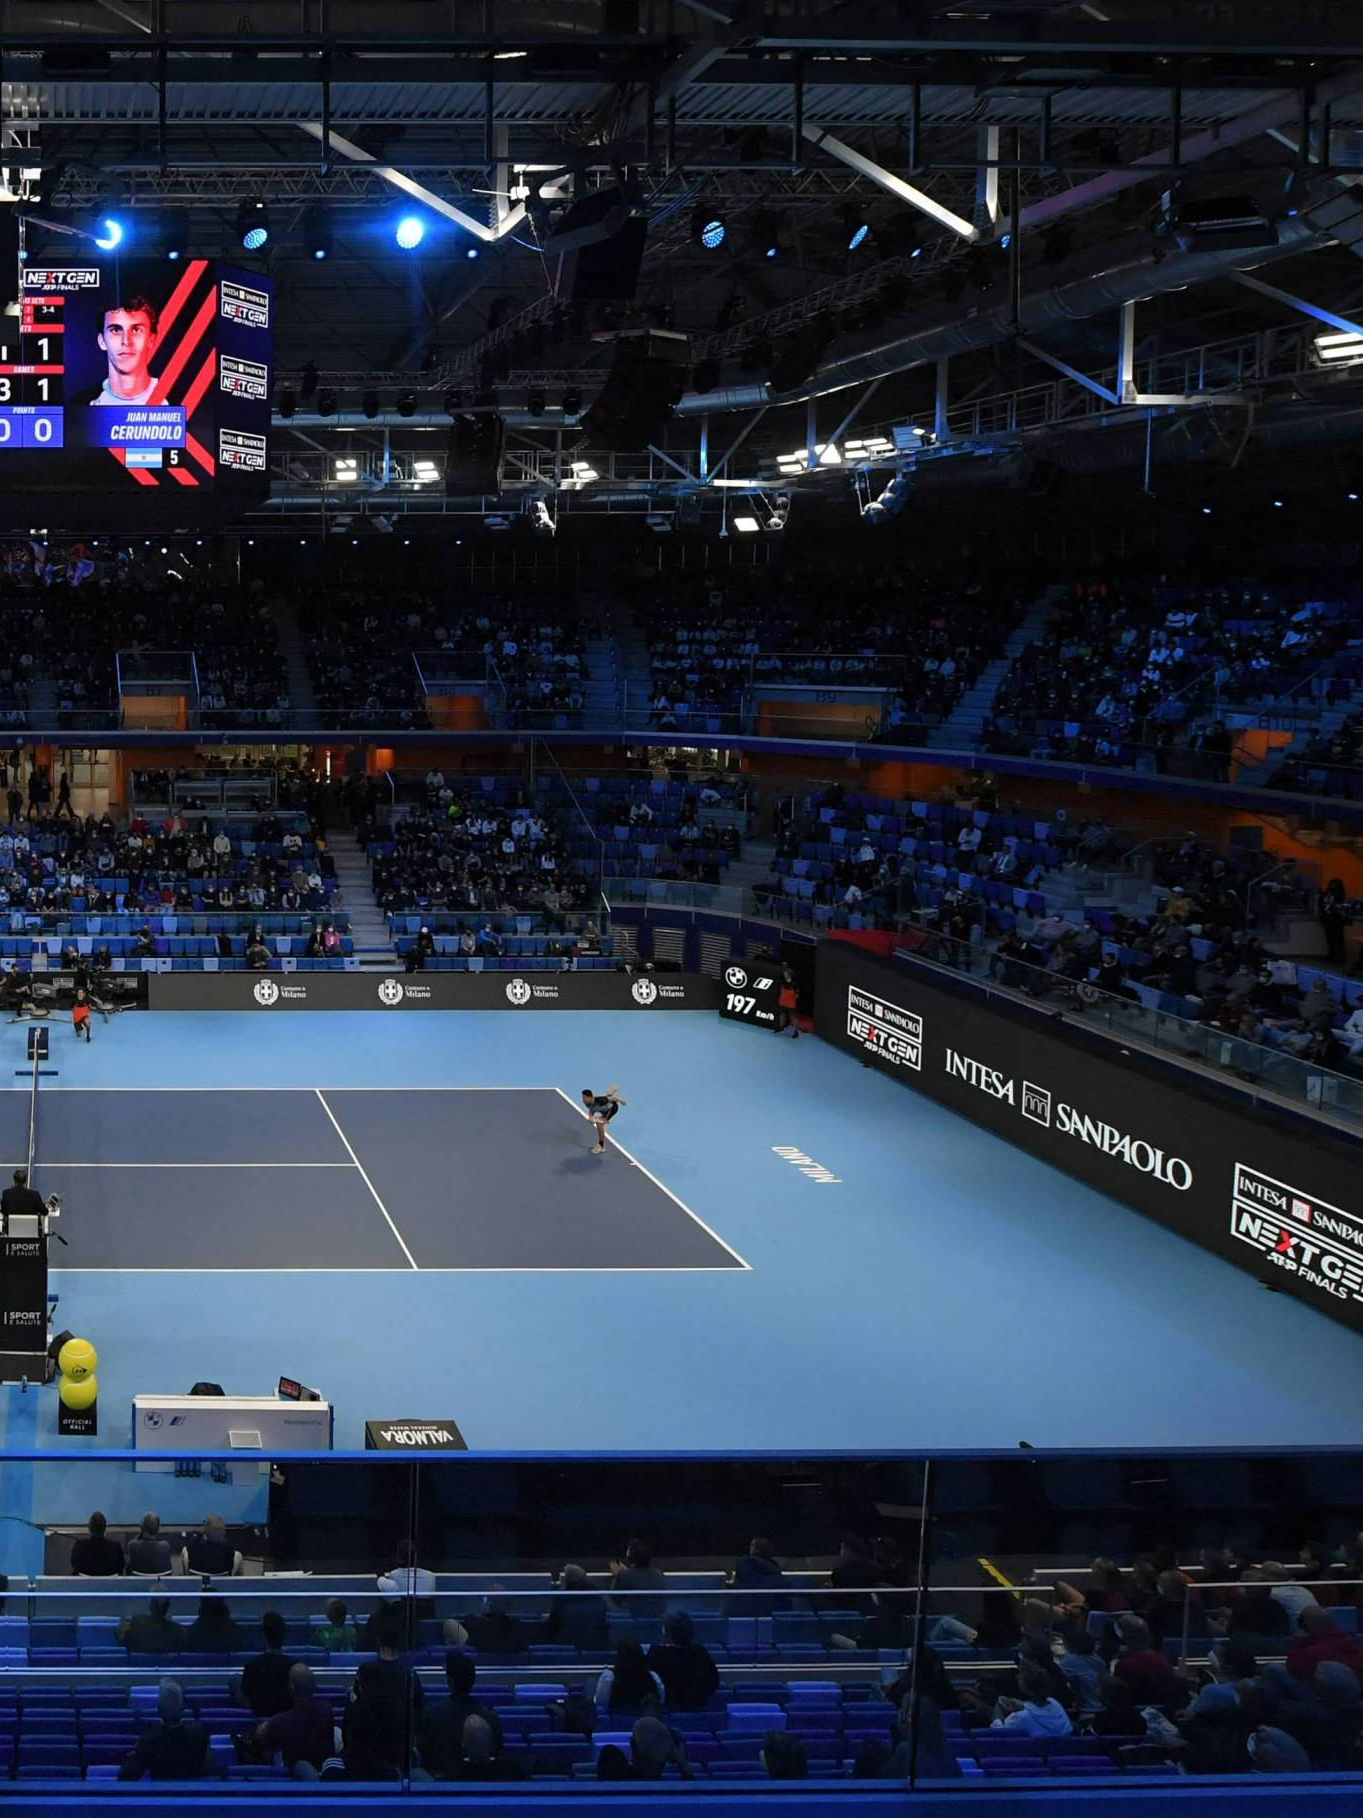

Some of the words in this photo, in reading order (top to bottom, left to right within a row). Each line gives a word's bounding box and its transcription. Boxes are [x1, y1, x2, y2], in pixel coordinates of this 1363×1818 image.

[27, 272, 67, 284] NEXT
[66, 272, 96, 284] GEN
[224, 303, 248, 318] NEXT
[248, 310, 266, 323] GEN
[38, 338, 49, 360] 1
[38, 378, 49, 401] 1
[223, 377, 247, 391] NEXT
[247, 383, 265, 395] GEN
[126, 412, 148, 422] JUAN
[148, 412, 181, 422] MANUEL
[34, 418, 52, 442] 0
[110, 425, 182, 440] CERUNDOLO
[170, 449, 178, 465] 5
[222, 450, 246, 463] NEXT
[246, 455, 263, 466] GEN
[726, 993, 756, 1014] 197
[756, 1010, 775, 1020] Km/h
[851, 1018, 888, 1047] NEXT
[888, 1037, 917, 1063] GEN
[878, 1048, 900, 1064] FINALS
[945, 1048, 1016, 1106] INTESA
[1056, 1103, 1193, 1191] SANPAOLO
[771, 1146, 843, 1183] MILANO
[1239, 1176, 1288, 1211] INTESA
[1313, 1211, 1363, 1246] SANPA
[11, 1243, 40, 1251] SPORT
[1239, 1212, 1320, 1266] NEXT
[1321, 1255, 1363, 1293] GE
[1267, 1252, 1298, 1272] ATP
[1298, 1267, 1349, 1299] FINALS
[9, 1311, 41, 1320] SPORT
[380, 1430, 454, 1445] VALMORA
